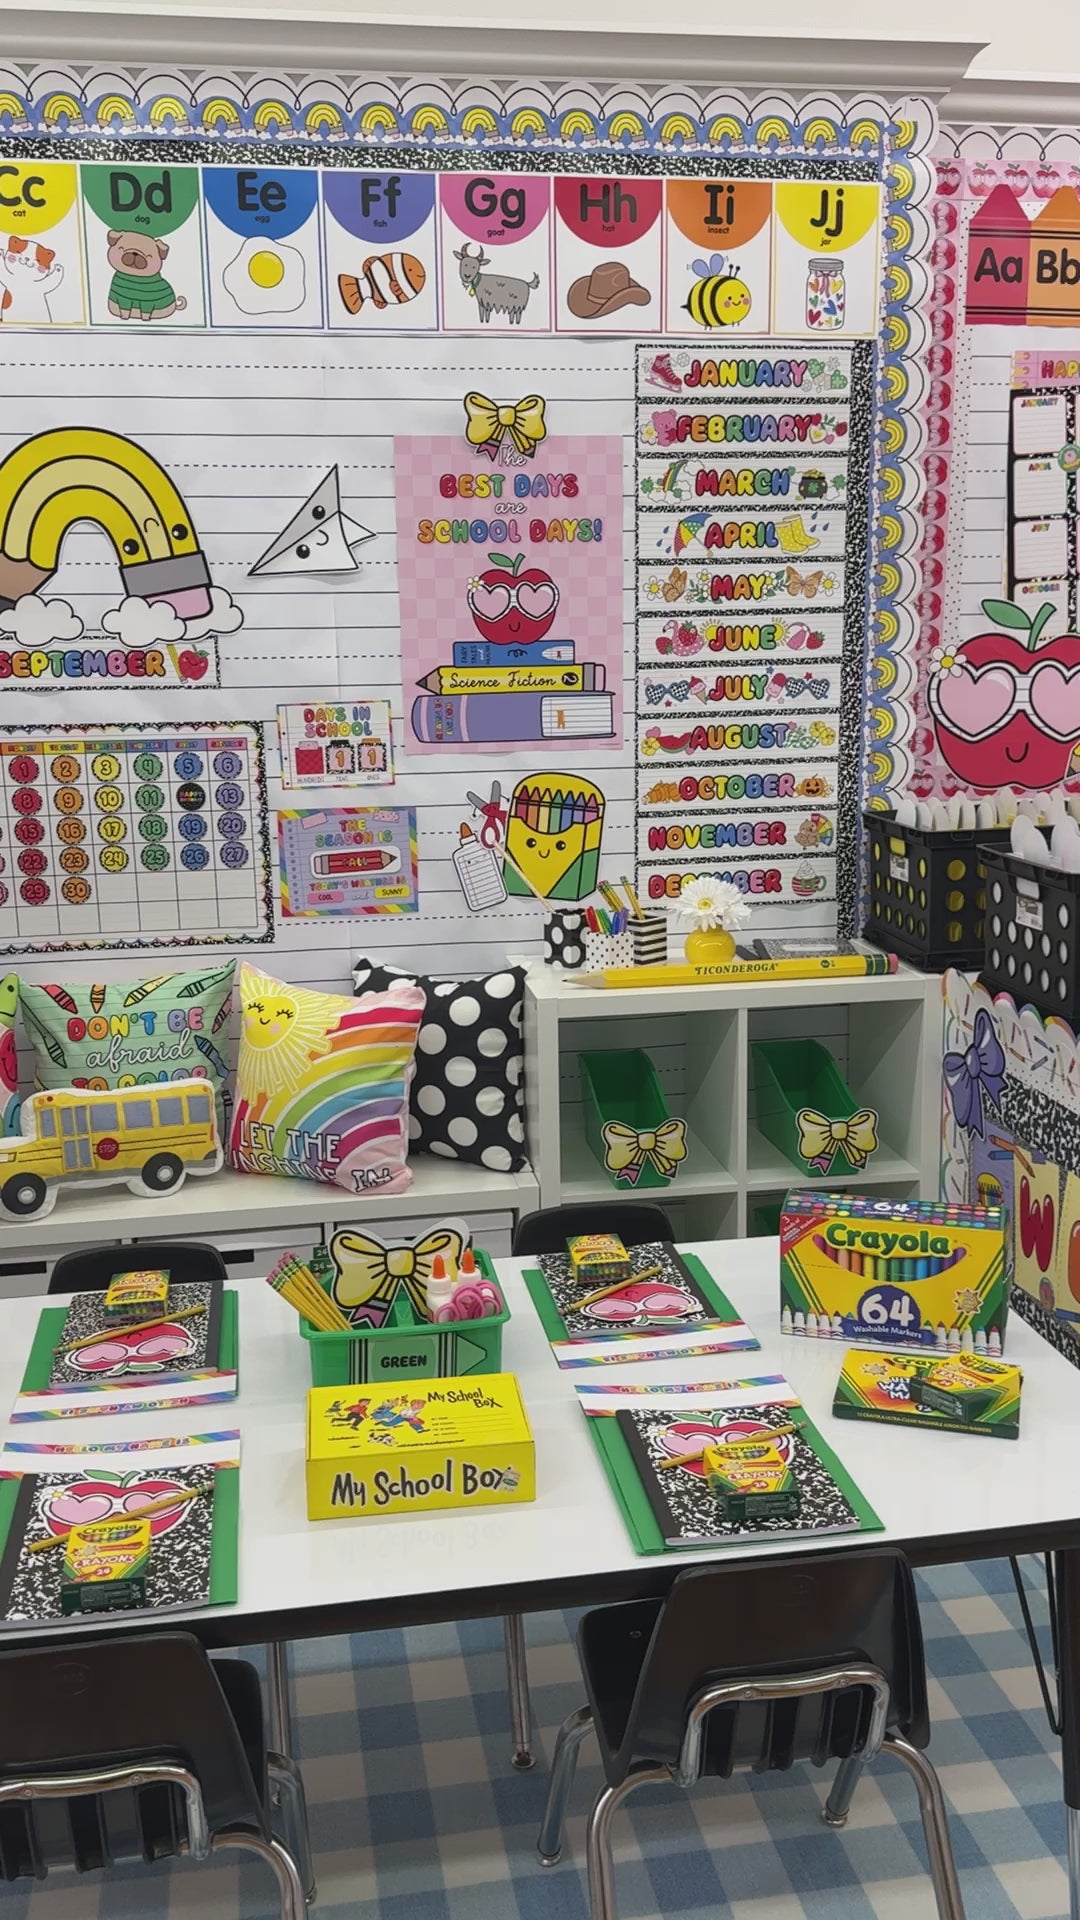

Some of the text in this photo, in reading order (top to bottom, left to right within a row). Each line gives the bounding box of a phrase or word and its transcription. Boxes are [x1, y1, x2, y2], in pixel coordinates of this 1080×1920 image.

[0, 165, 46, 207] Cc
[110, 170, 172, 213] Dd
[236, 172, 287, 212] Ee
[360, 176, 402, 218] Ff
[464, 177, 526, 229] Gg
[579, 182, 637, 223] Hh
[704, 184, 734, 226] Ii
[12, 209, 27, 217] cat
[134, 214, 151, 225] dog
[254, 215, 271, 224] egg
[809, 188, 844, 238] Jj
[373, 219, 388, 228] fish
[602, 224, 616, 233] hat
[707, 225, 730, 234] insect
[487, 227, 505, 238] goat
[820, 237, 832, 248] jar
[974, 247, 1023, 284] Aa
[1036, 247, 1080, 286] Bb
[684, 359, 809, 388] JANUARY
[1041, 359, 1080, 379] HAP
[676, 414, 813, 443] FEBRUARY
[499, 444, 528, 467] The
[439, 473, 579, 499] BEST DAYS
[695, 468, 790, 496] MARCH
[494, 502, 528, 514] are
[417, 518, 604, 544] SCHOOL DAYS!
[704, 521, 779, 549] APRIL
[711, 574, 766, 601] MAY
[708, 624, 778, 651] JUNE
[0, 649, 166, 678] SEPTEMBER
[449, 672, 500, 689] Science
[507, 670, 557, 688] Fiction
[708, 674, 769, 701] JULY
[303, 706, 371, 723] DAYS IN
[304, 721, 373, 738] SCHOOL
[689, 723, 789, 751] AUGUST
[335, 750, 345, 768] 1
[367, 748, 377, 766] 1
[19, 761, 29, 778] 1
[60, 761, 73, 778] 2
[100, 760, 112, 776] 3
[142, 759, 154, 776] 4
[183, 758, 195, 774] 5
[221, 758, 234, 774] 6
[679, 773, 796, 801] OCTOBER
[21, 793, 33, 809] 8
[62, 792, 75, 809] 9
[99, 791, 120, 807] 10
[142, 790, 159, 806] 11
[221, 788, 239, 804] 13
[21, 823, 38, 839] 15
[63, 823, 81, 839] 16
[104, 821, 122, 837] 17
[145, 819, 161, 836] 18
[184, 818, 200, 835] 19
[223, 817, 241, 834] 20
[338, 819, 367, 832] THE
[315, 830, 393, 848] SEASON IS
[648, 821, 787, 851] NOVEMBER
[23, 854, 42, 869] 22
[64, 852, 84, 868] 23
[104, 850, 124, 866] 24
[146, 849, 164, 865] 25
[186, 848, 203, 864] 26
[225, 847, 243, 862] 27
[25, 882, 44, 897] 29
[66, 882, 86, 898] 30
[648, 869, 782, 899] DECBER
[695, 963, 776, 976] TICONDEROGA
[67, 1007, 204, 1042] DON'T BE
[86, 1027, 194, 1073] afraid
[98, 1143, 118, 1154] STOP
[239, 1119, 341, 1163] LET THE
[873, 1201, 911, 1212] 64
[782, 1215, 791, 1223] 3
[1020, 1175, 1055, 1272] W
[826, 1223, 951, 1256] Crayola
[861, 1293, 915, 1327] 64
[853, 1325, 922, 1339] Washable Markers
[380, 1355, 428, 1369] GREEN
[893, 1356, 939, 1368] Cray
[427, 1387, 483, 1403] My School
[473, 1397, 503, 1409] Box
[330, 1472, 366, 1506] My
[373, 1458, 453, 1506] School
[727, 1471, 784, 1480] CRAYONS
[83, 1524, 138, 1534] Crayola
[73, 1554, 136, 1568] CRAYONS
